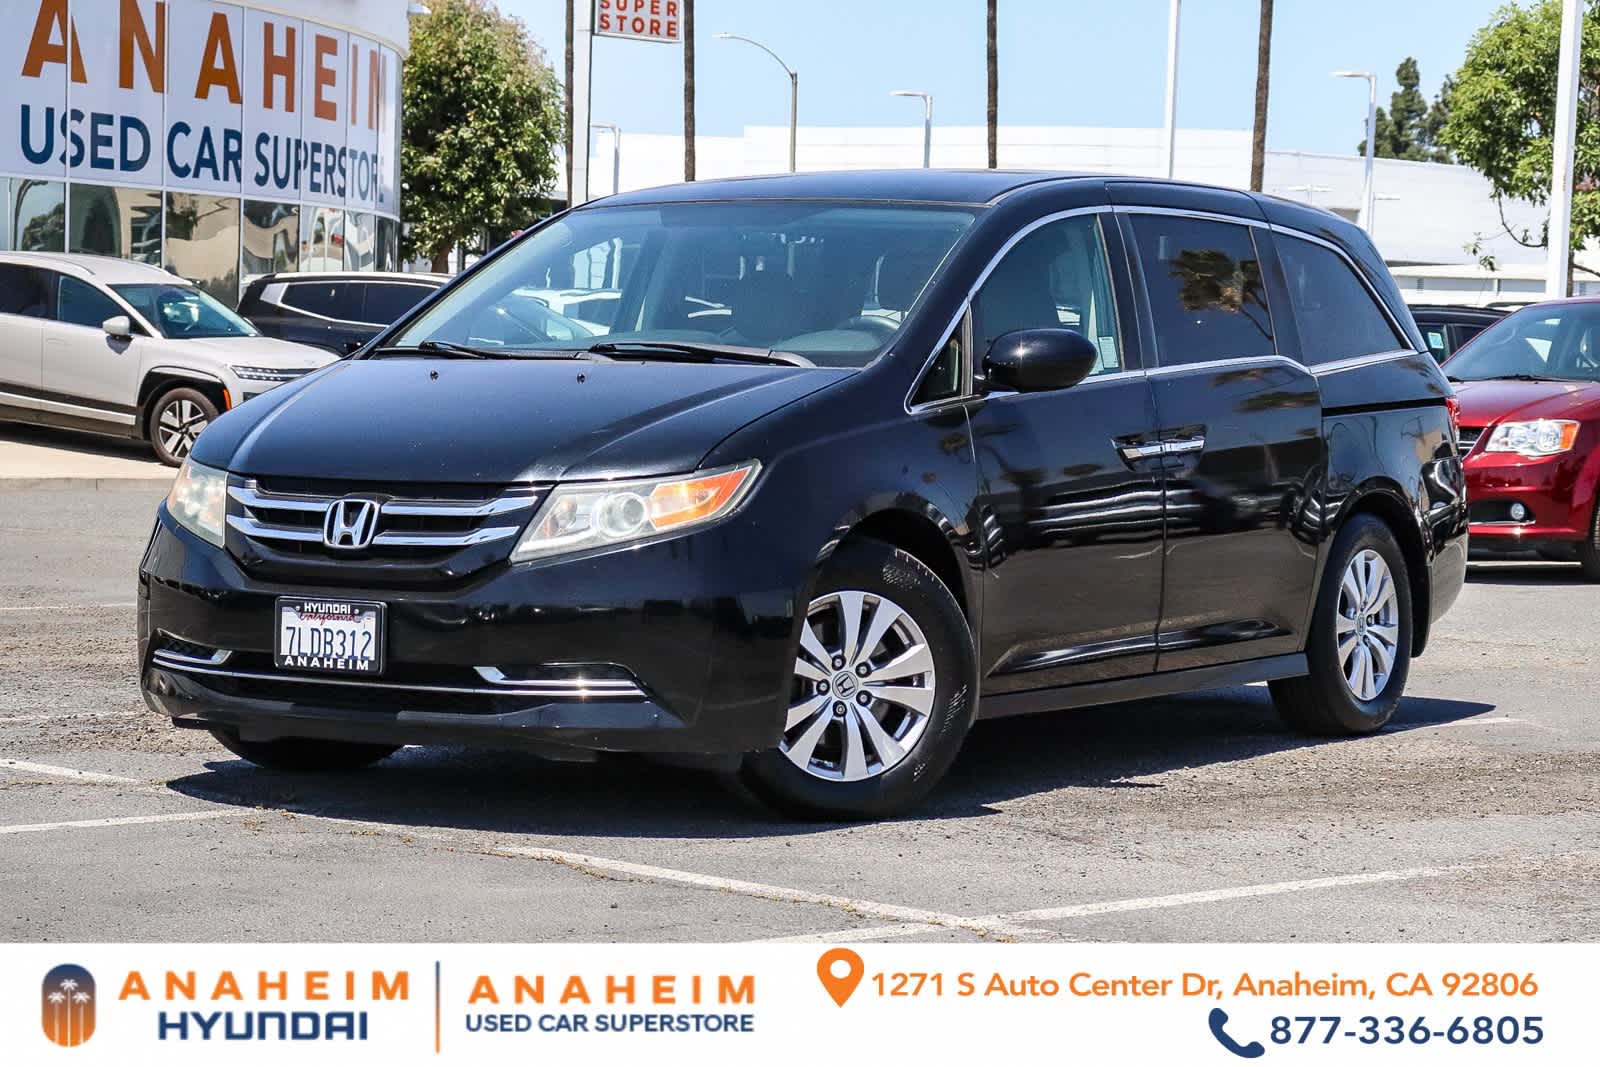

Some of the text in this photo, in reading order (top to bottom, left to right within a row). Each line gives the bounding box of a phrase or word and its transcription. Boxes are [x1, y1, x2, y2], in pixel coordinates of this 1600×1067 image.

[600, 0, 678, 17] SUPER
[600, 14, 678, 37] STORE
[20, 104, 151, 172] USED
[167, 121, 242, 183] CAR
[304, 602, 351, 614] HYUNDAI
[286, 626, 372, 661] 7LDB312
[284, 656, 369, 671] ANAHEIM
